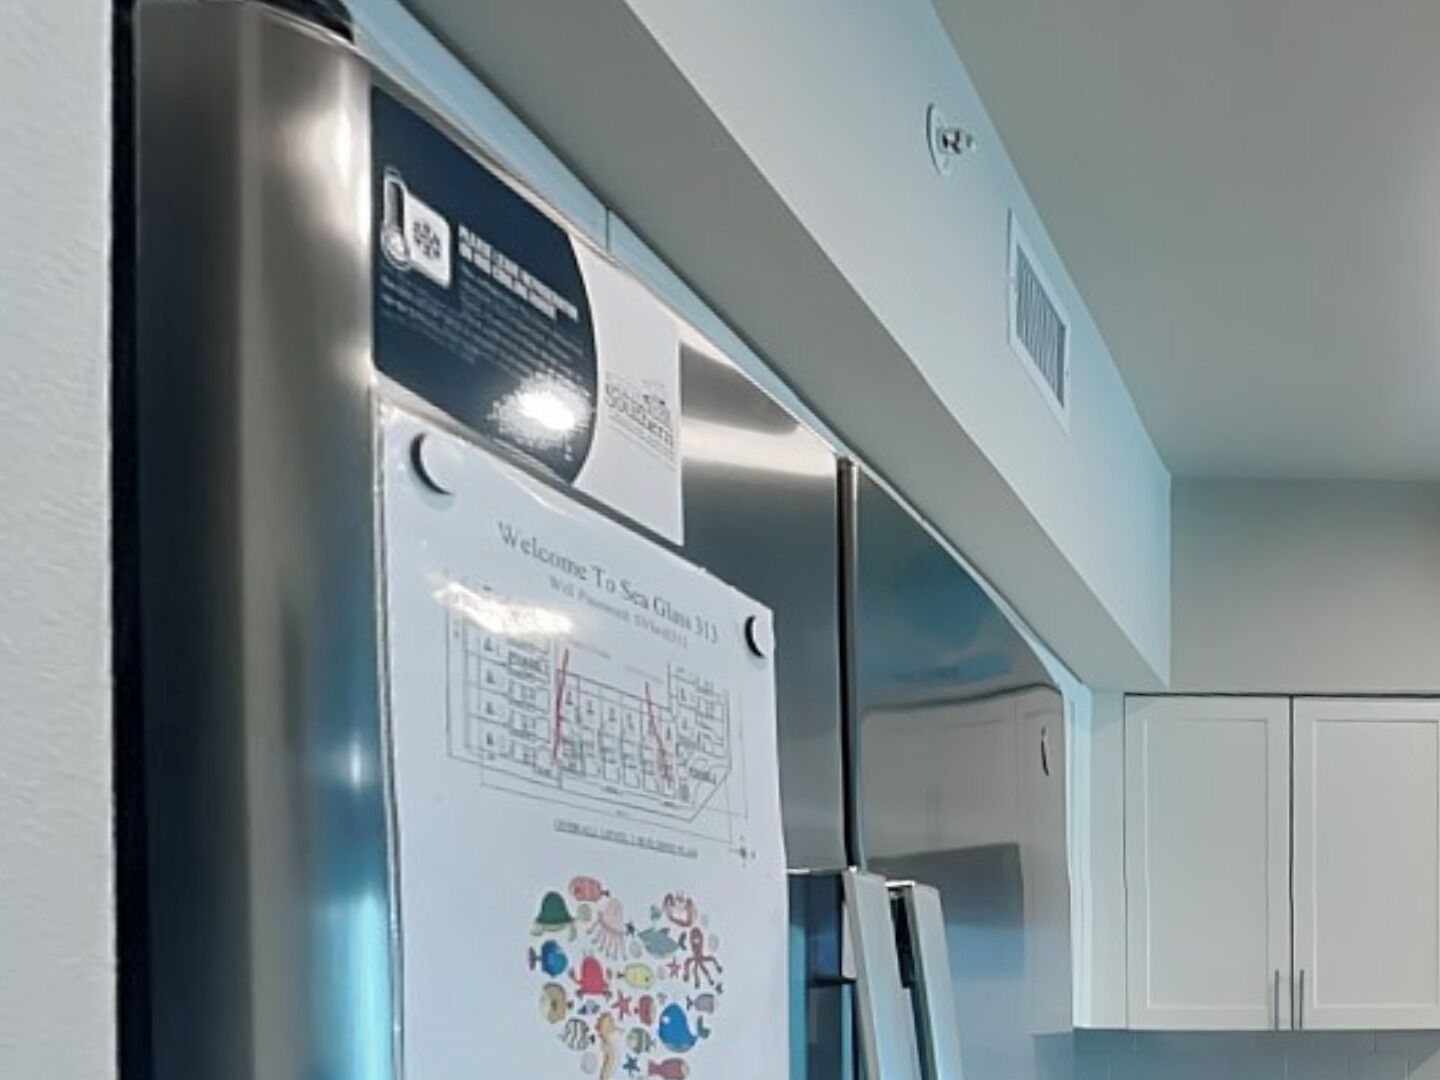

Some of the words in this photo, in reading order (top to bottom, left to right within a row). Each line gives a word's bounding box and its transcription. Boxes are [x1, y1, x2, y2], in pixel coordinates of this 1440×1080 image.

[498, 521, 587, 581] Welcome
[591, 564, 615, 593] To
[620, 577, 648, 608] Sea
[653, 596, 692, 630] Glass
[694, 614, 718, 643] 313
